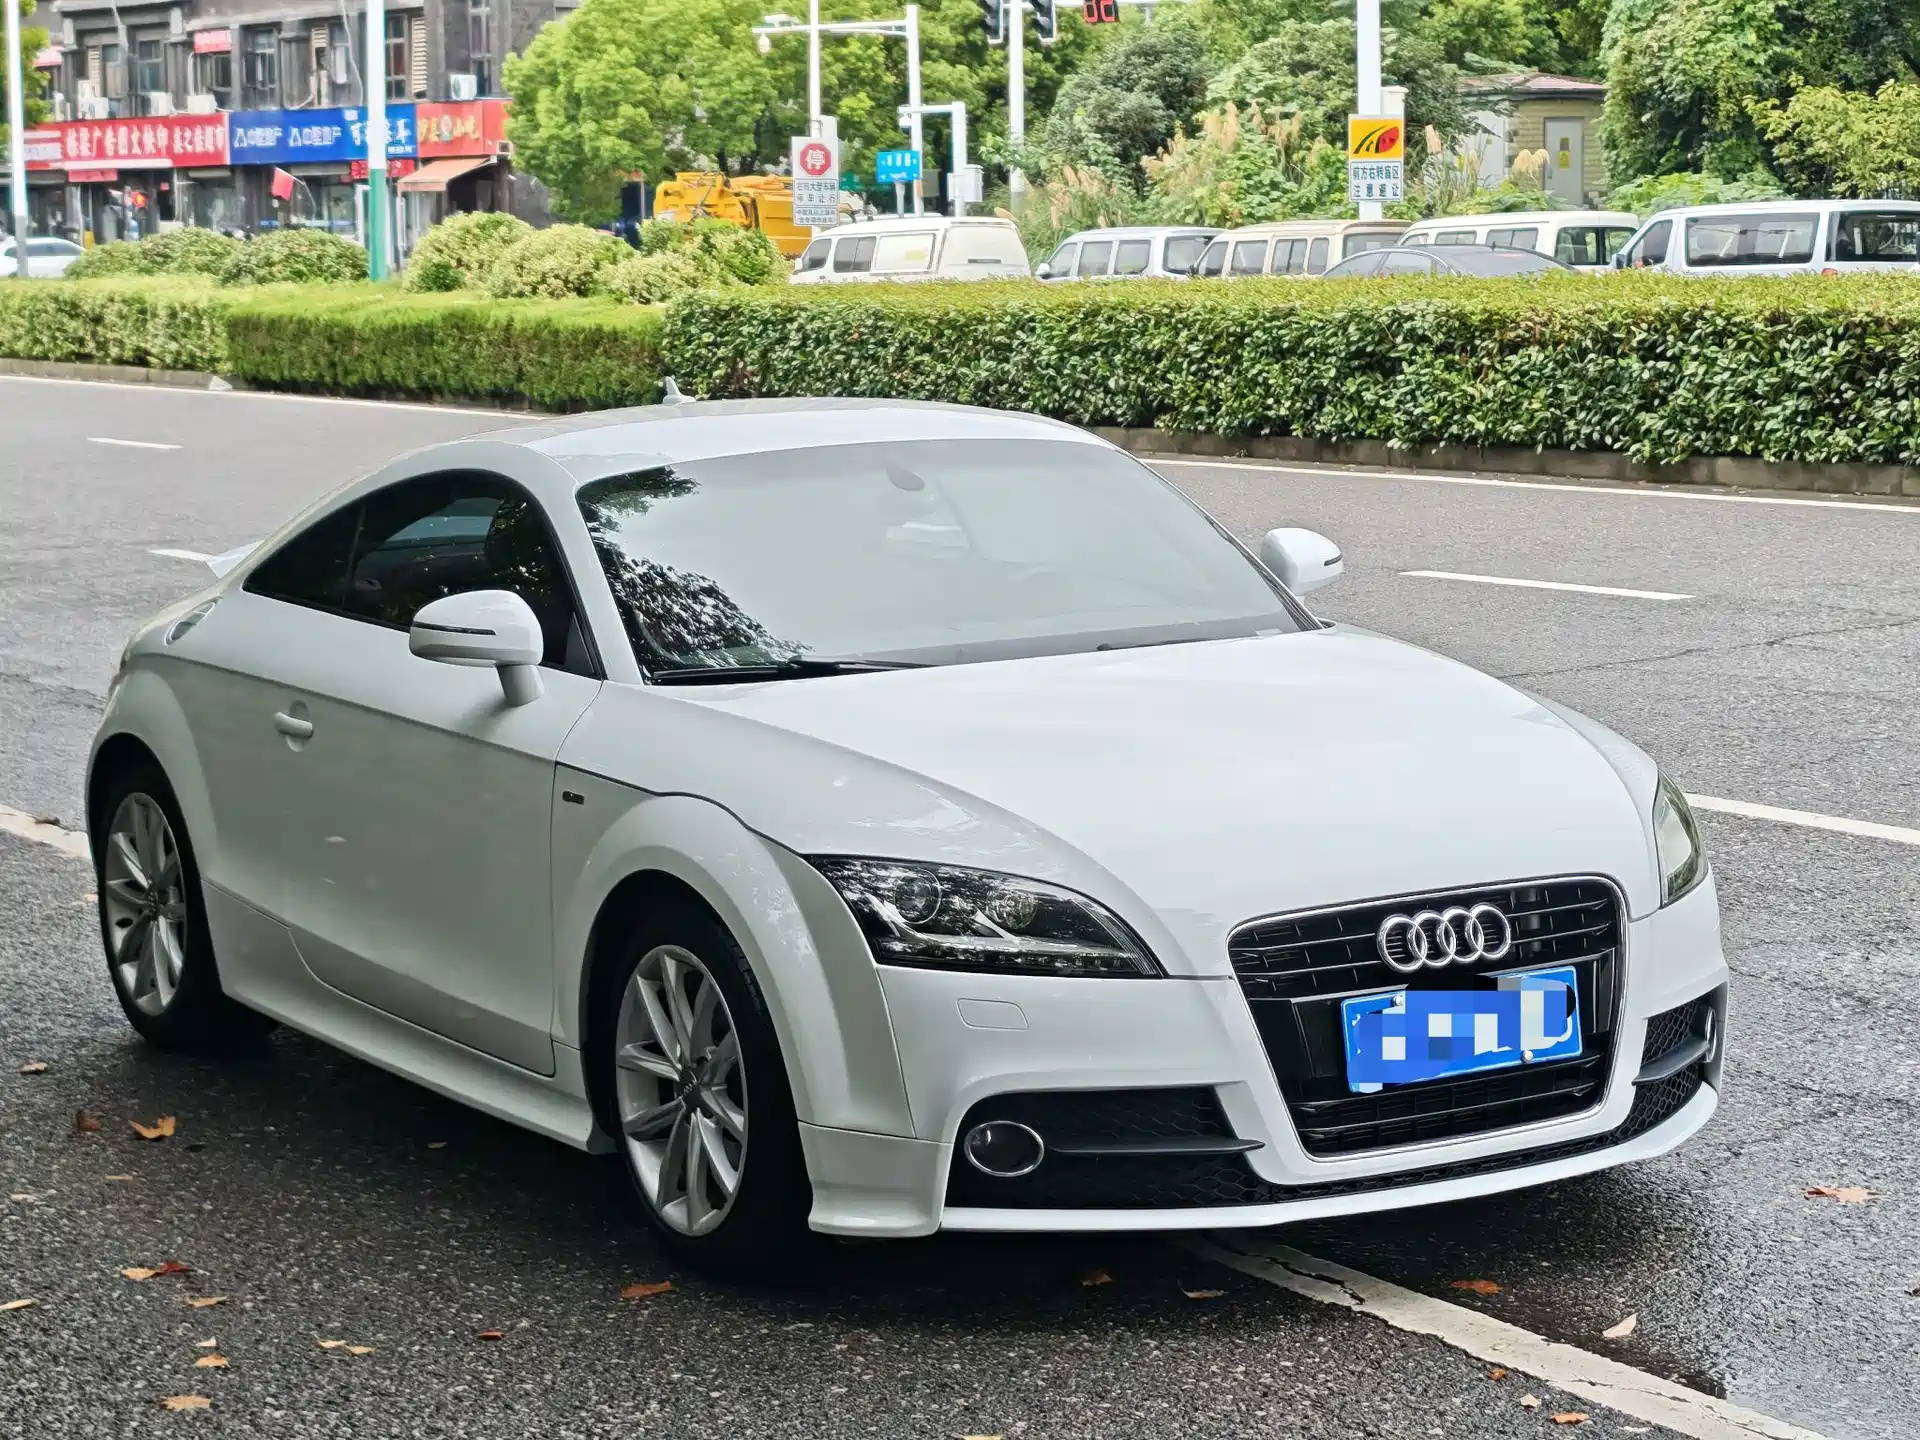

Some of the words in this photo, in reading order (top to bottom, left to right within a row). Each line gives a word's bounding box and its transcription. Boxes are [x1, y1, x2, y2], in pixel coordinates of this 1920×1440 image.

[806, 149, 826, 170] 停
[1353, 183, 1399, 198] 注意避让
